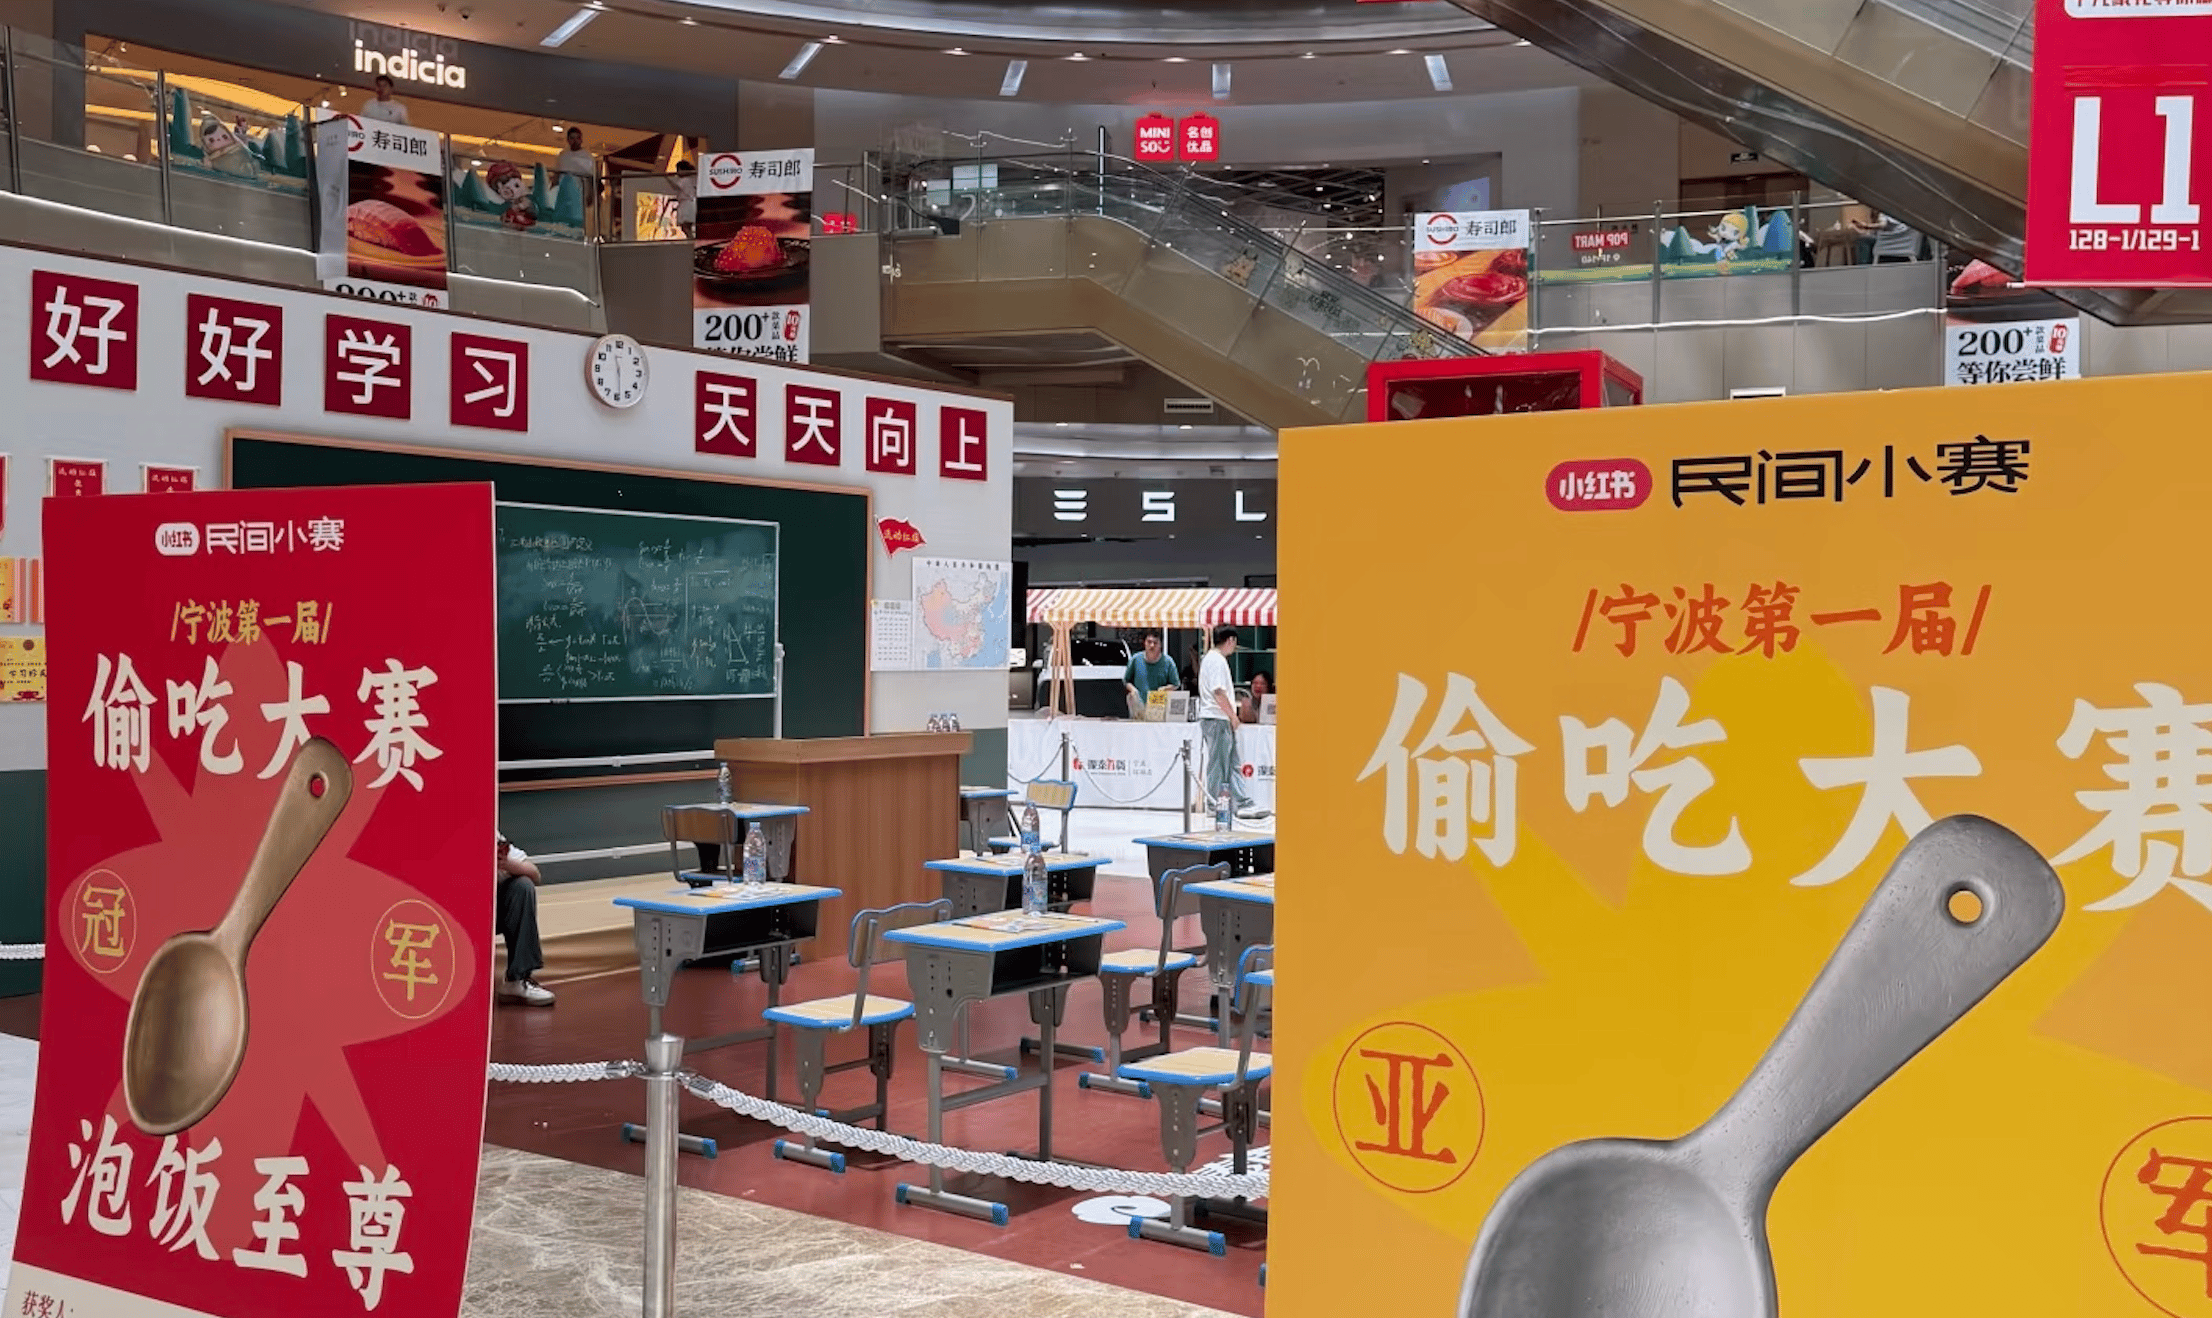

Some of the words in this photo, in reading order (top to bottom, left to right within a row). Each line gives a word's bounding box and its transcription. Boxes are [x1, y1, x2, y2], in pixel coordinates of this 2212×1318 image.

[354, 38, 467, 89] indicia
[372, 129, 428, 156] 寿司郎
[1140, 127, 1171, 139] MINI
[2069, 96, 2201, 224] L1
[748, 160, 801, 179] 寿司郎
[1465, 220, 1517, 236] 寿司郎
[2069, 229, 2200, 251] 128-1/129-1
[1957, 357, 2067, 384] 等你尝鲜
[1558, 470, 1637, 501] 小红书
[1670, 435, 2031, 509] 民间小赛
[160, 530, 193, 549] 小红书
[205, 515, 346, 555] 民间小赛
[82, 652, 444, 793] 偷吃大赛
[1356, 672, 2212, 913] 偷吃大赛
[81, 883, 126, 959] 冠
[382, 919, 442, 1002] 军
[1354, 1047, 1458, 1165] 亚
[60, 1113, 415, 1312] 泡饭至尊
